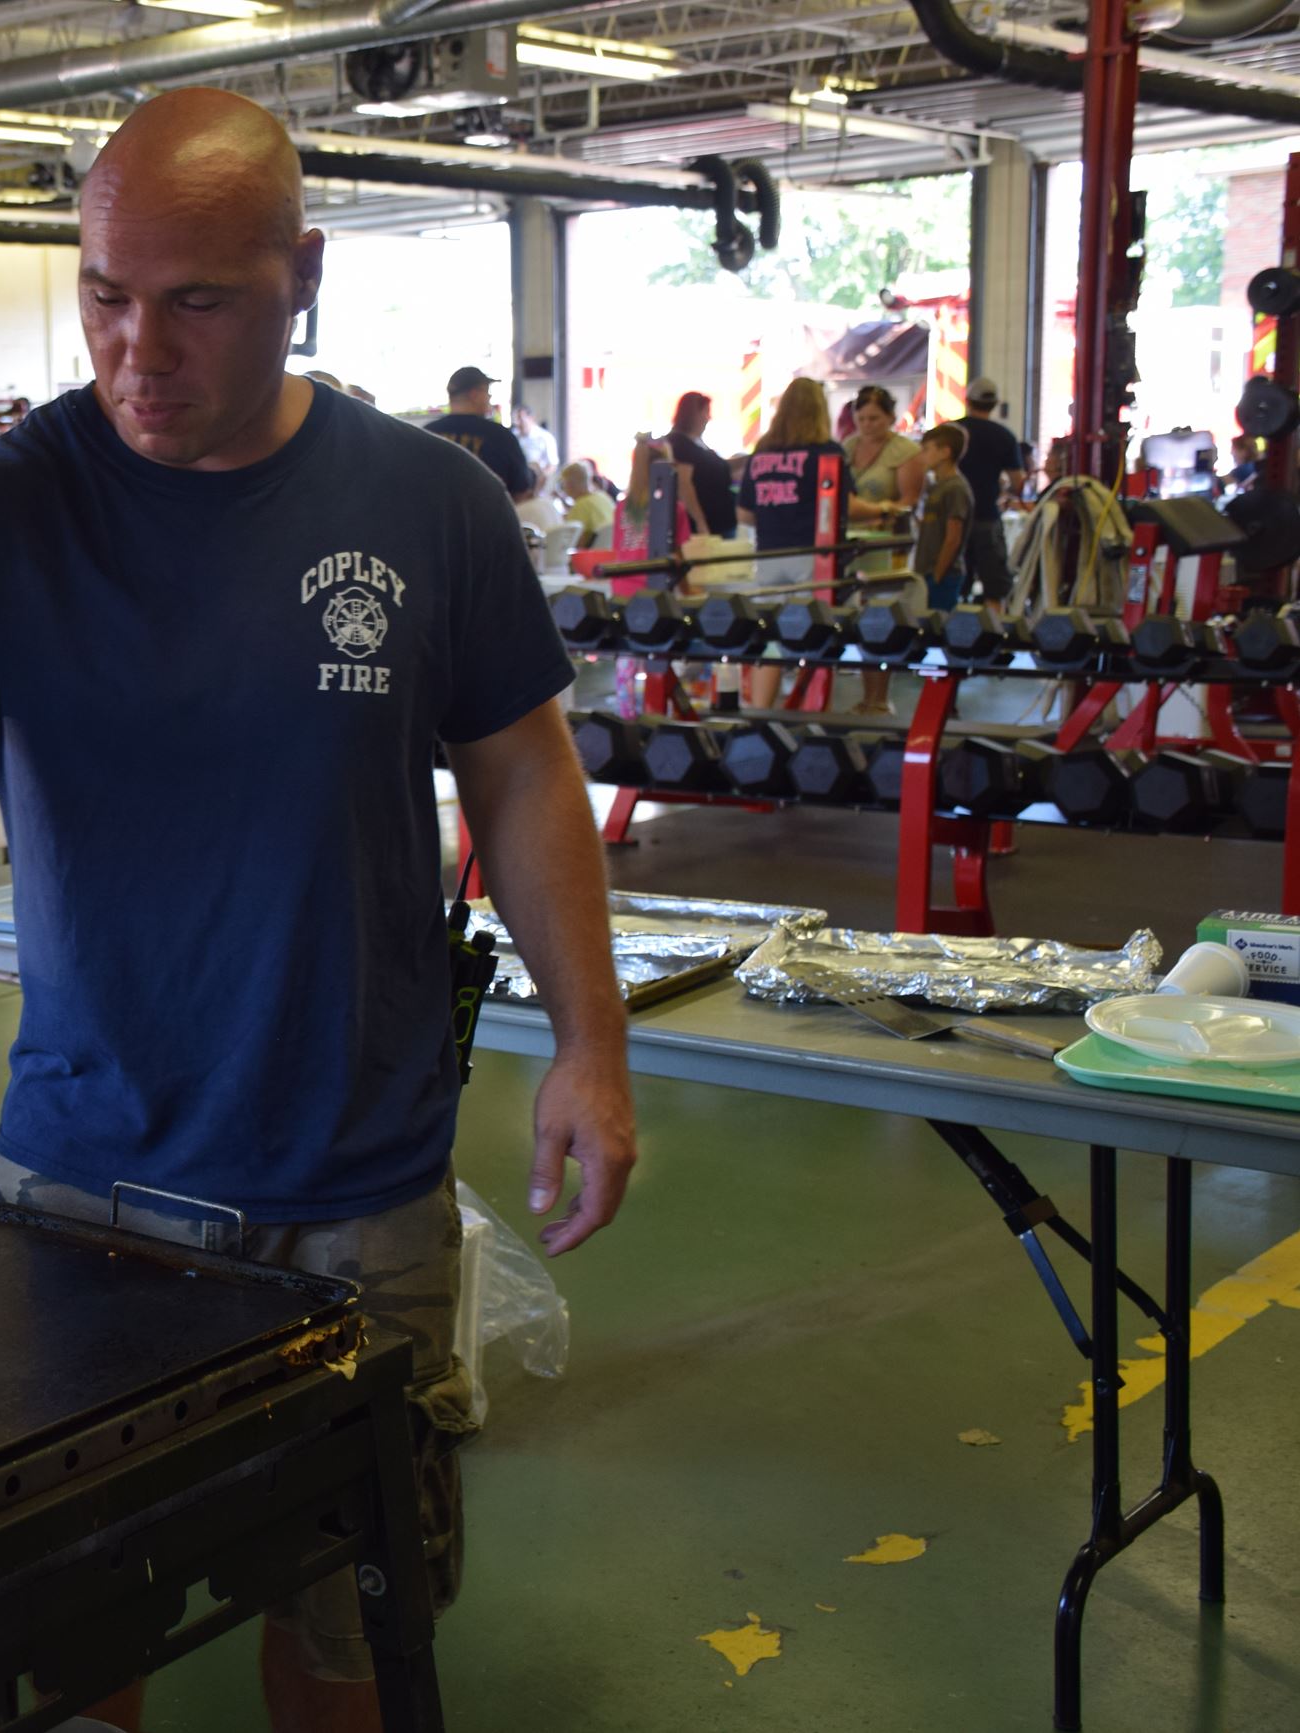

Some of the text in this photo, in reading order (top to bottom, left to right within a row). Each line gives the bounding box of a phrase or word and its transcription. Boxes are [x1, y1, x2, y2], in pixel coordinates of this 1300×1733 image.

[301, 551, 406, 607] COPLEY
[317, 663, 391, 694] FIRE
[1250, 951, 1278, 961] FOOD
